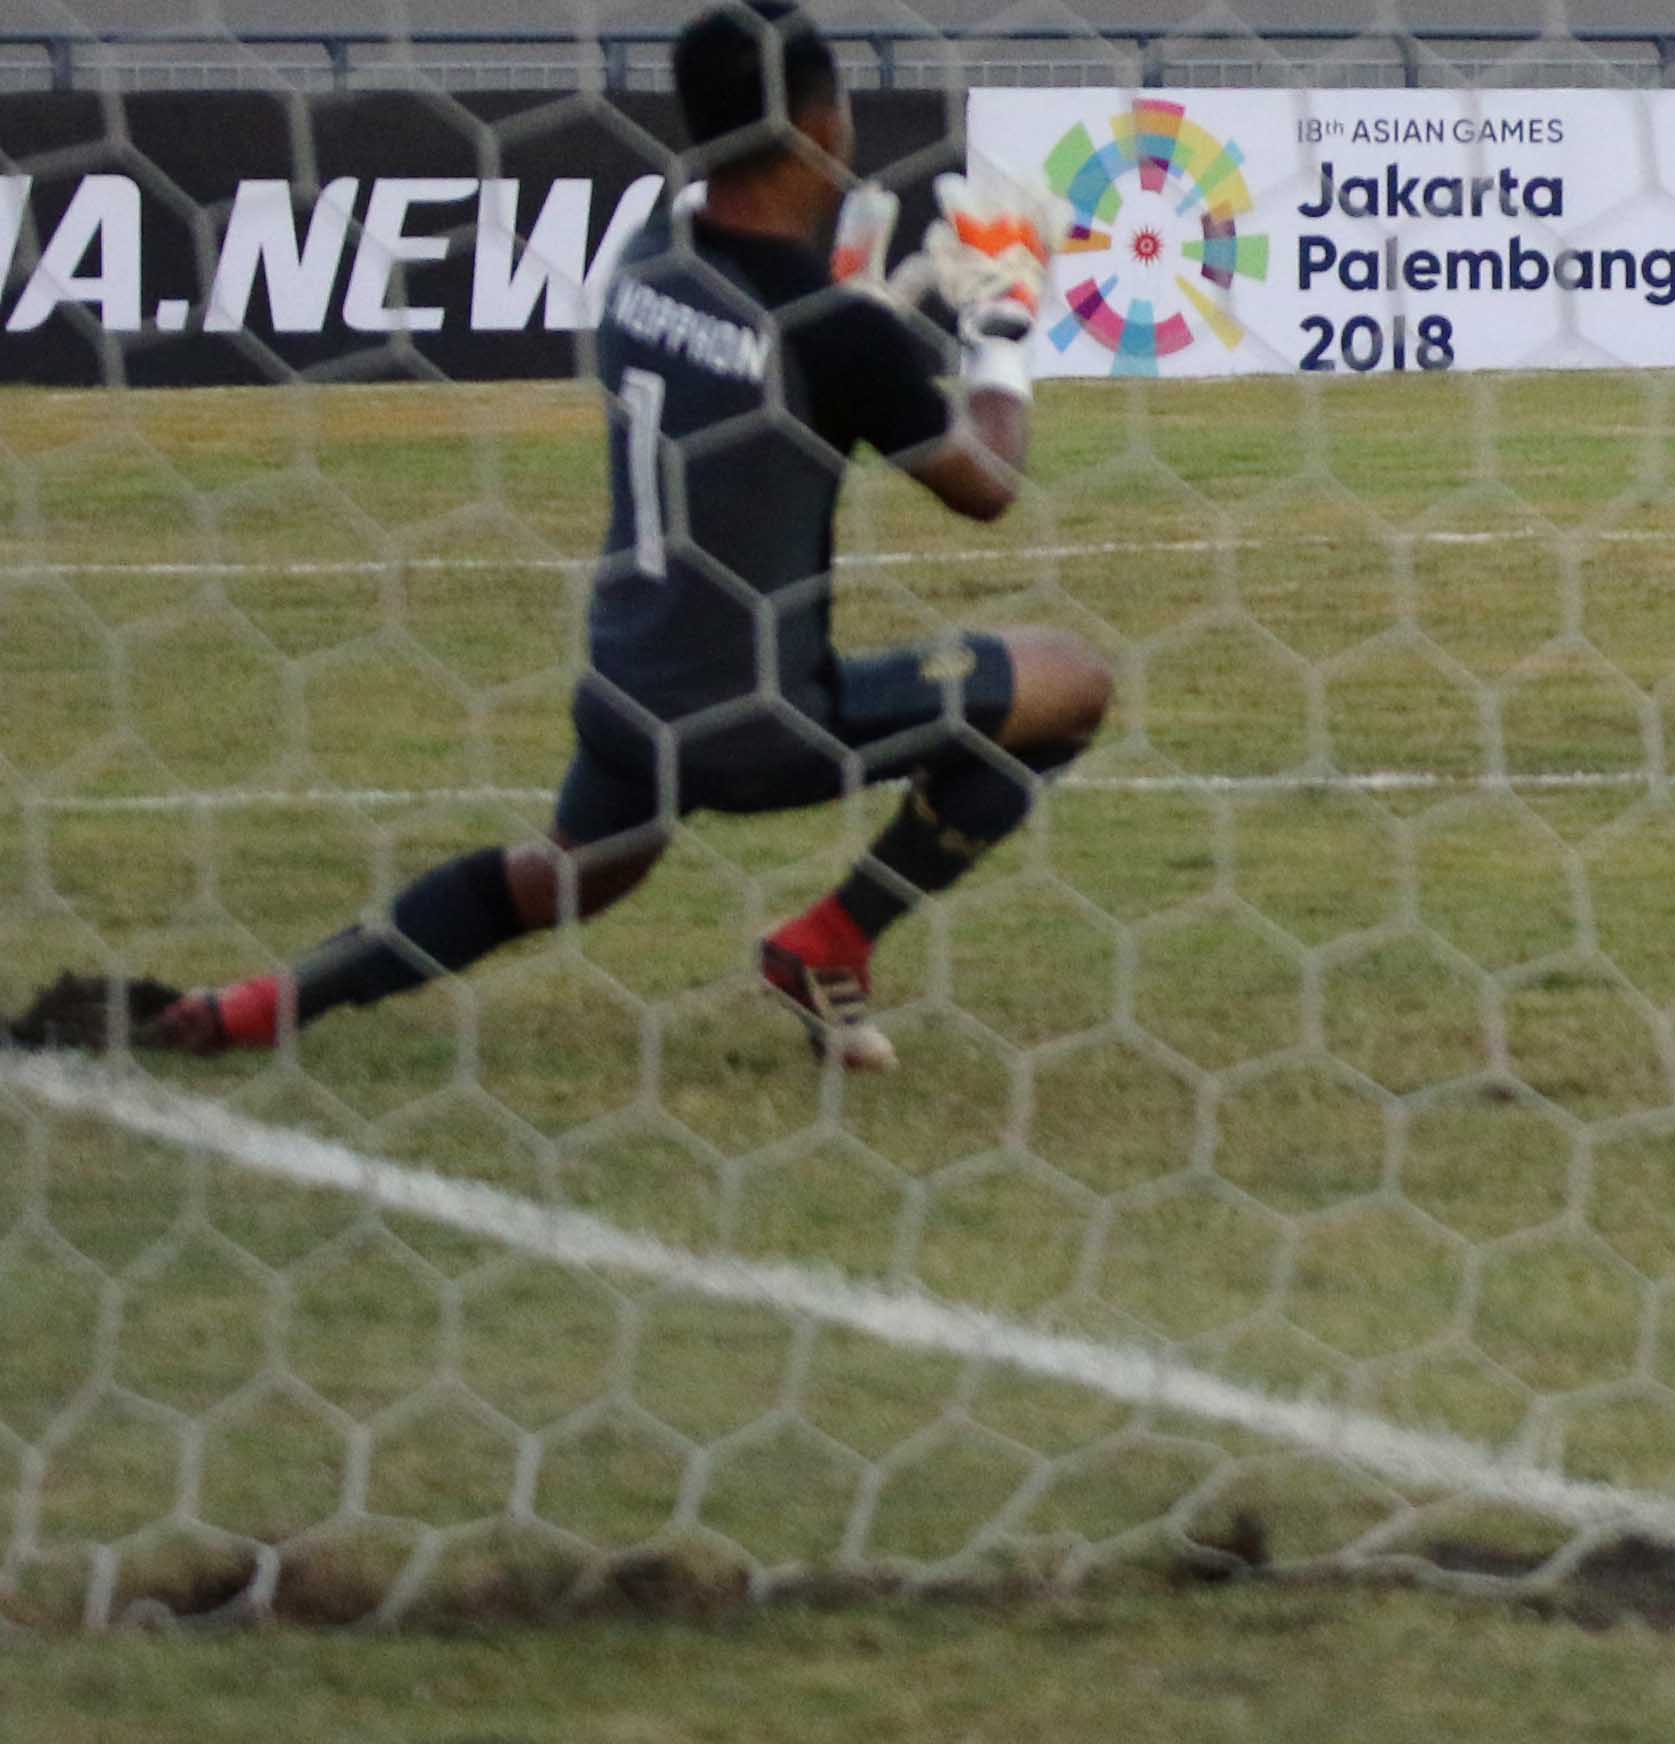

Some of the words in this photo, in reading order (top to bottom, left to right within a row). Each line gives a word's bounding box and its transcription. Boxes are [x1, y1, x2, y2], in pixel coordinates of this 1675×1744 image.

[1351, 118, 1445, 144] ASIAN
[1452, 118, 1564, 144] GAMES
[1297, 160, 1564, 219] Jakarta
[1297, 314, 1455, 371] 2018
